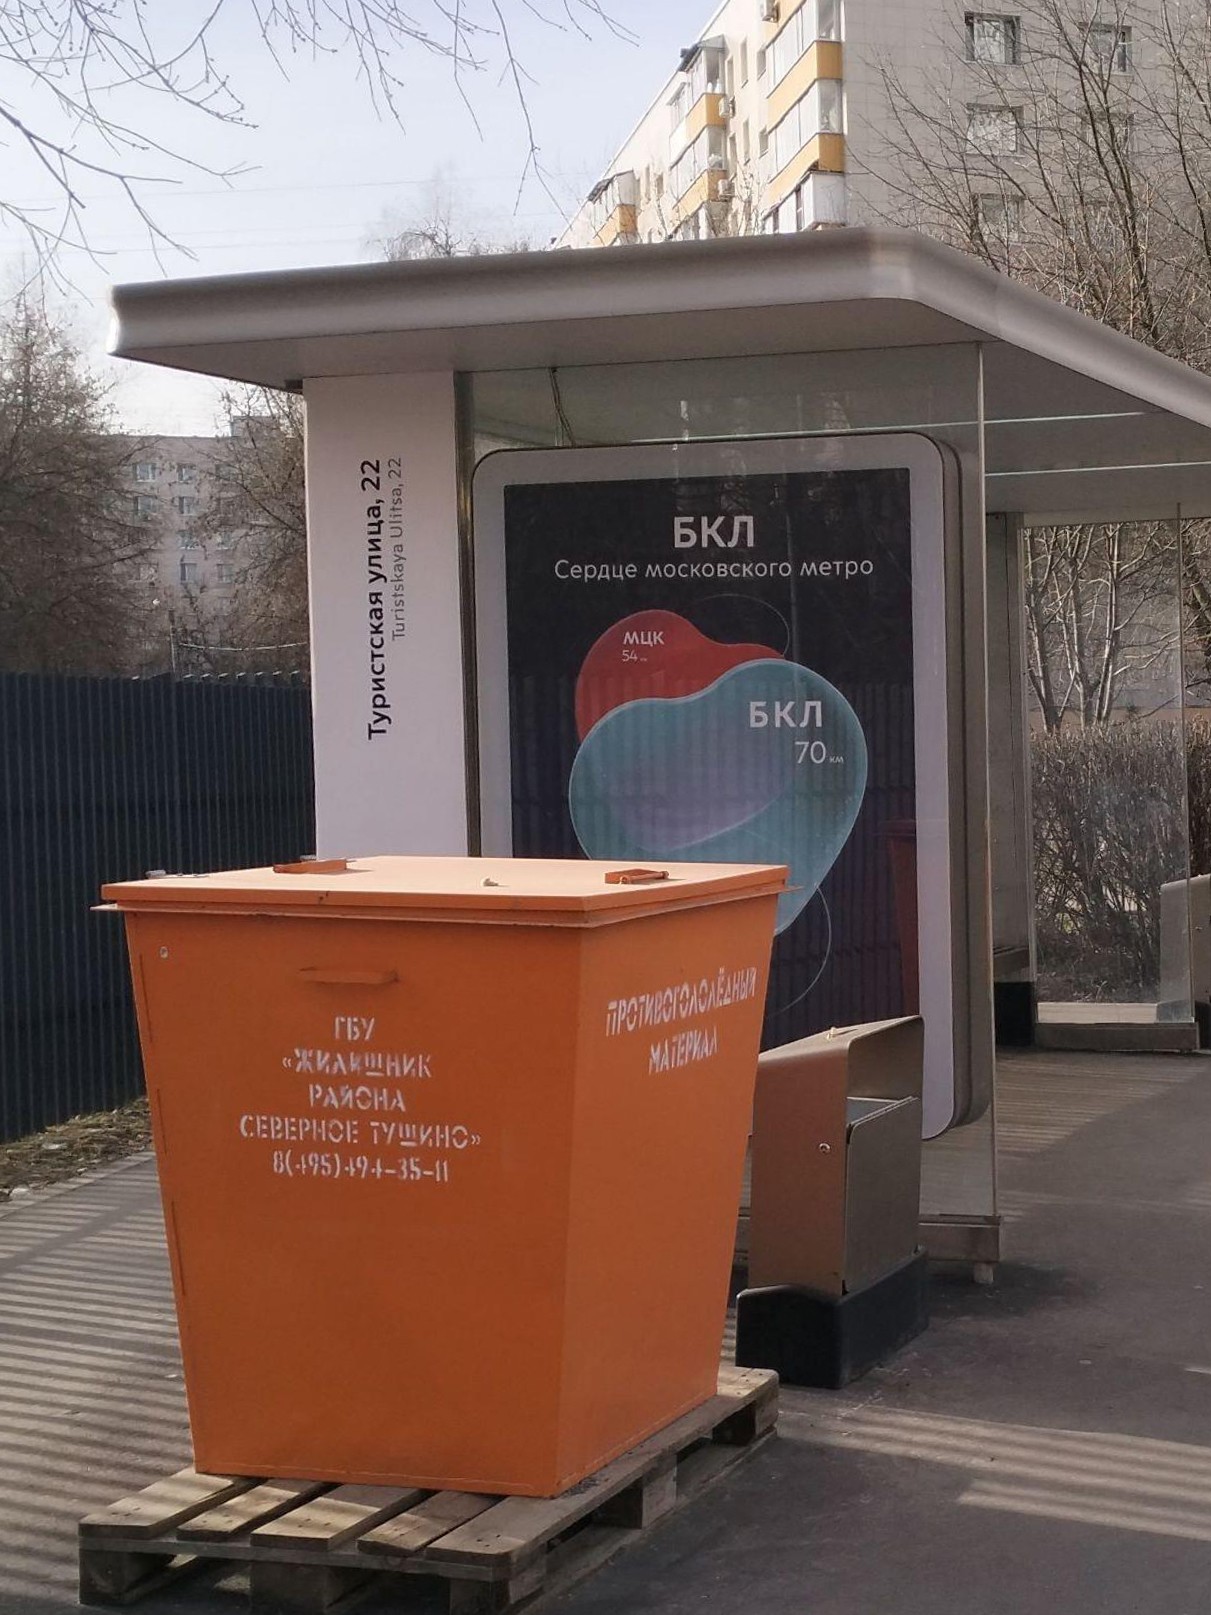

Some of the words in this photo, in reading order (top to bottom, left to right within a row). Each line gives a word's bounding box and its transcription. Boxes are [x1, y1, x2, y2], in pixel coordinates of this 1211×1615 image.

[360, 459, 380, 492] 22
[387, 457, 402, 479] 22
[388, 483, 404, 539] Ulitsa,
[366, 498, 388, 584] улица,
[673, 515, 755, 549] БКЛ
[553, 558, 638, 582] Сердце
[645, 560, 792, 579] московского
[799, 558, 874, 580] метро
[390, 544, 407, 642] Turistskaya
[622, 630, 665, 647] МЦК
[367, 592, 392, 741] Туристская
[621, 649, 638, 662] 54
[749, 701, 822, 728] БКЛ
[794, 740, 826, 764] 70
[334, 1016, 376, 1041] ГБУ
[648, 1025, 719, 1076] МАТЕРИАЛ
[308, 1083, 407, 1113] РАЙОНА
[239, 1114, 359, 1144] СЕВЕРНОЕ
[370, 1120, 481, 1150] ТУШИНО»
